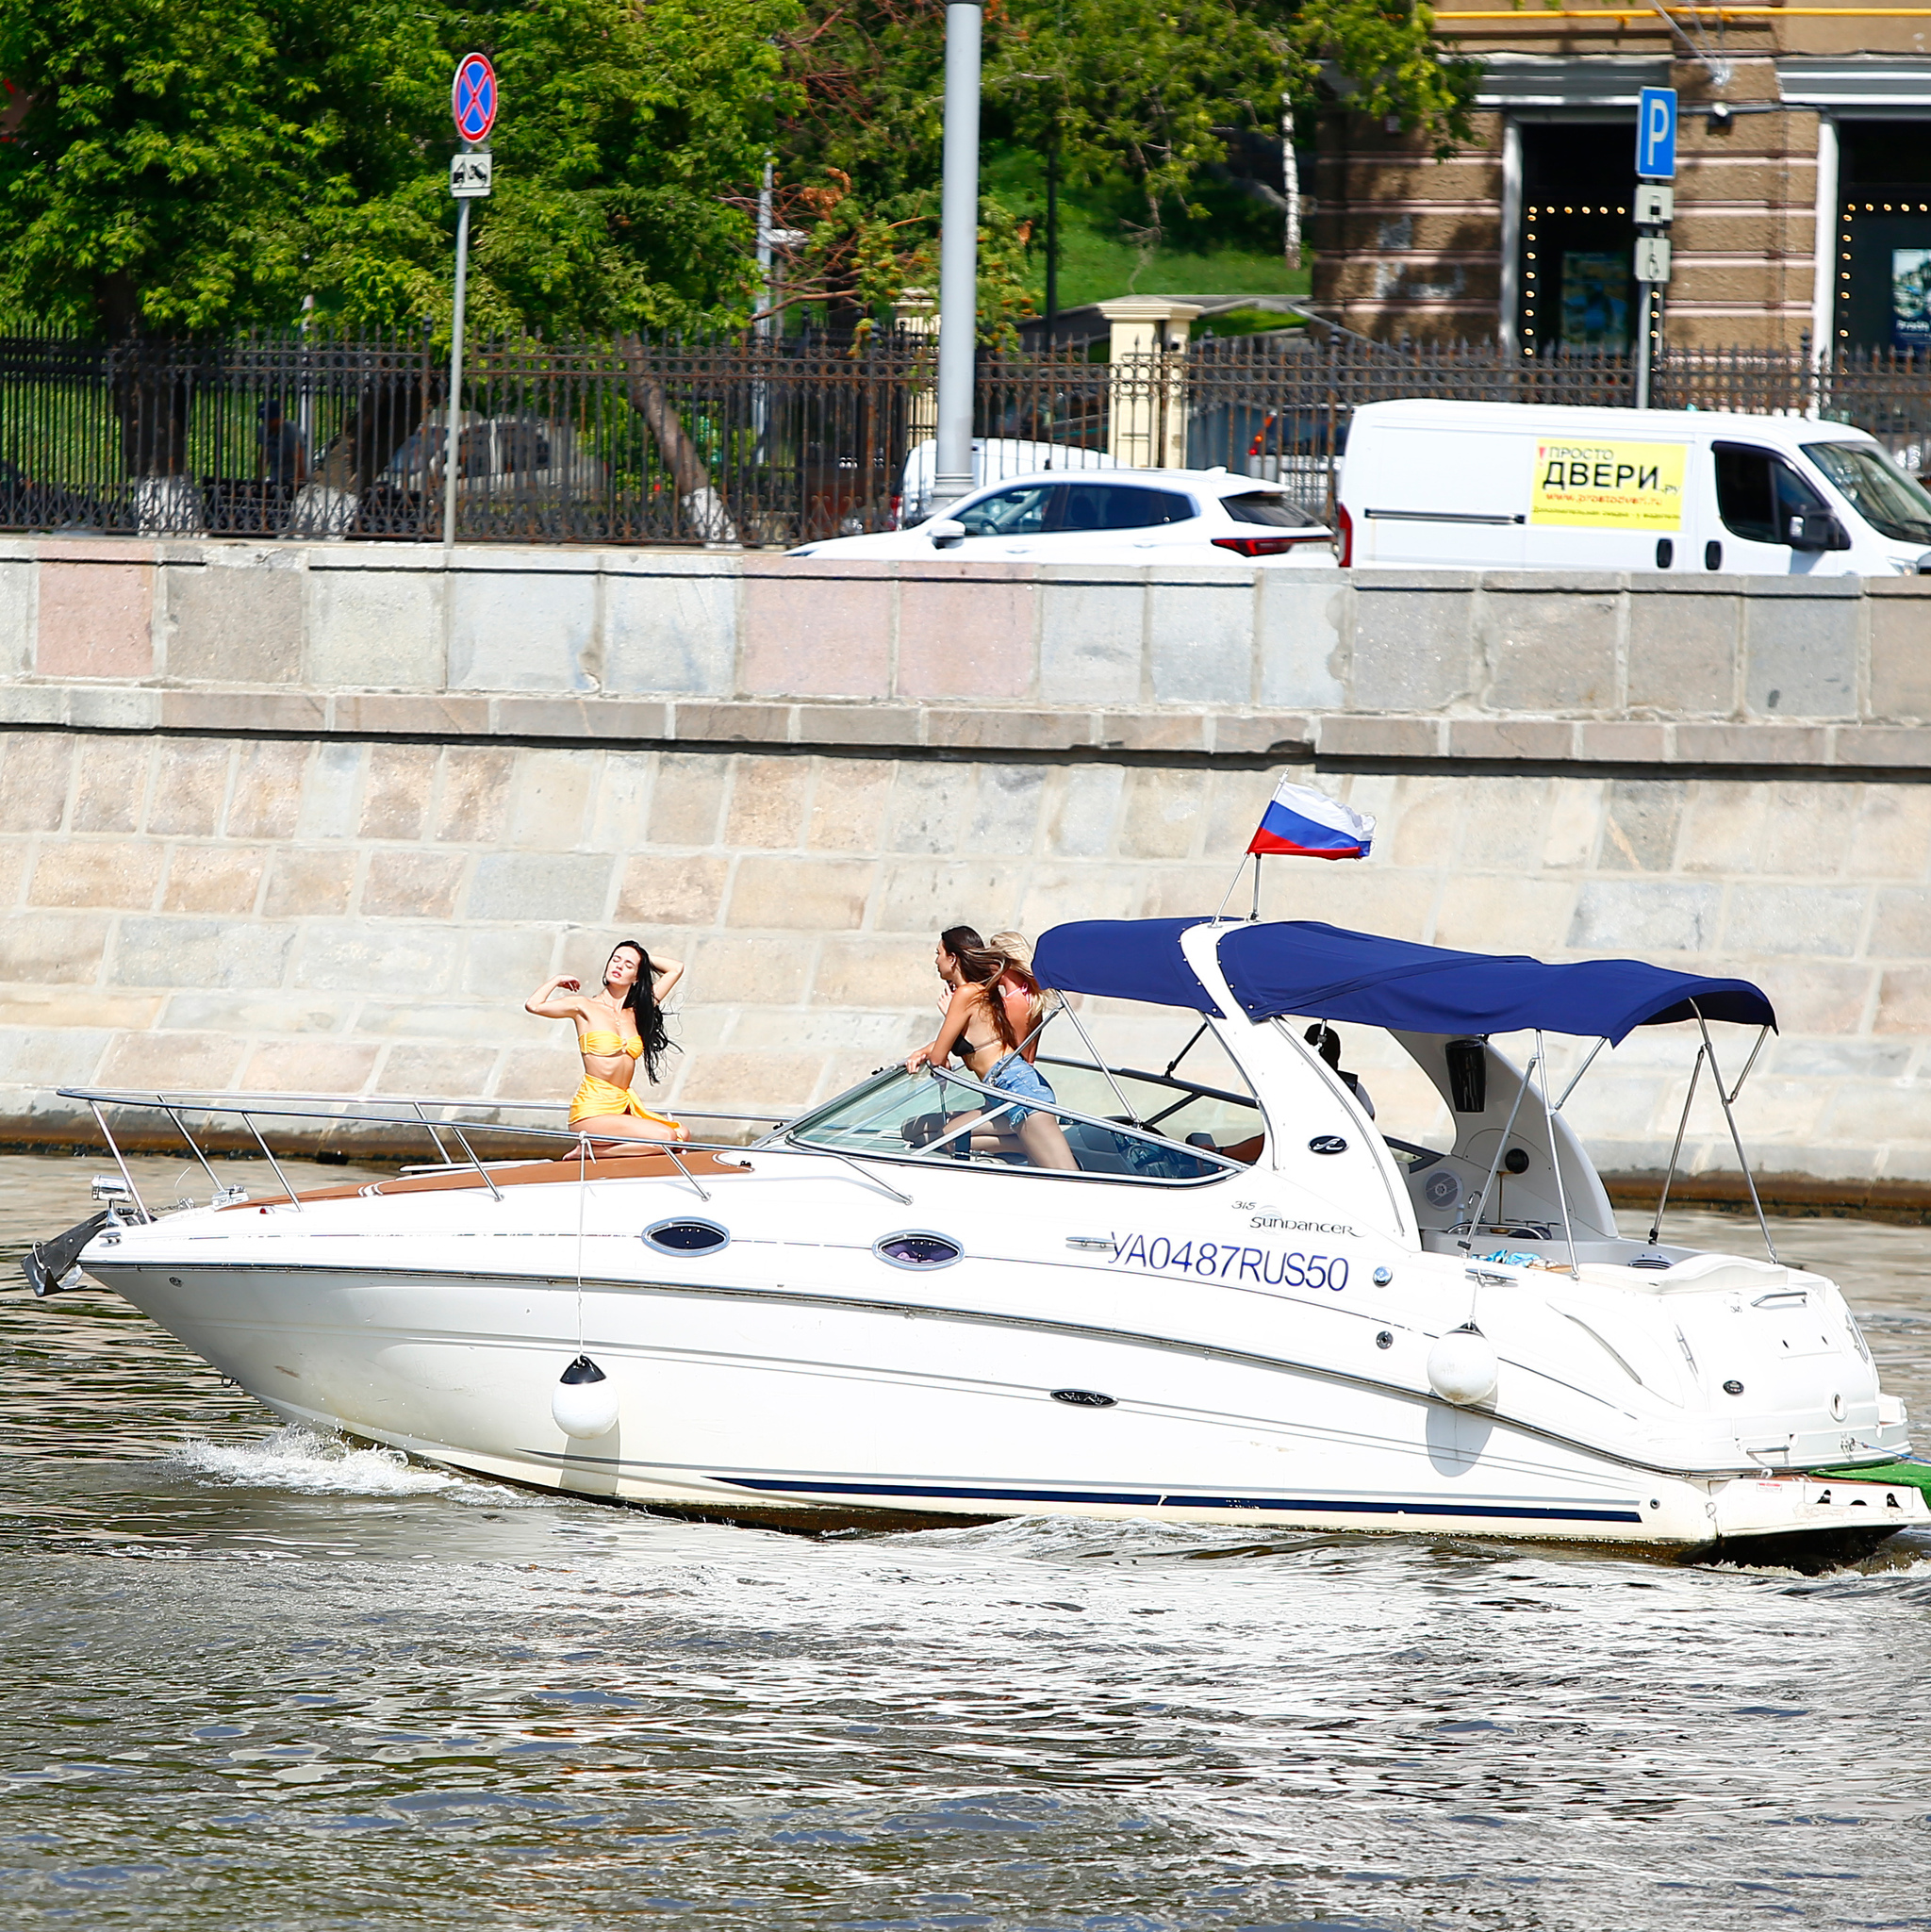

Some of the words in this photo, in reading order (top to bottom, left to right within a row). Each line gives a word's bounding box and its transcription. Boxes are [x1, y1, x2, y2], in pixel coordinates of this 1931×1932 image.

[1647, 99, 1670, 166] P
[1549, 446, 1614, 460] ПРОСТО
[1231, 1200, 1257, 1211] 315
